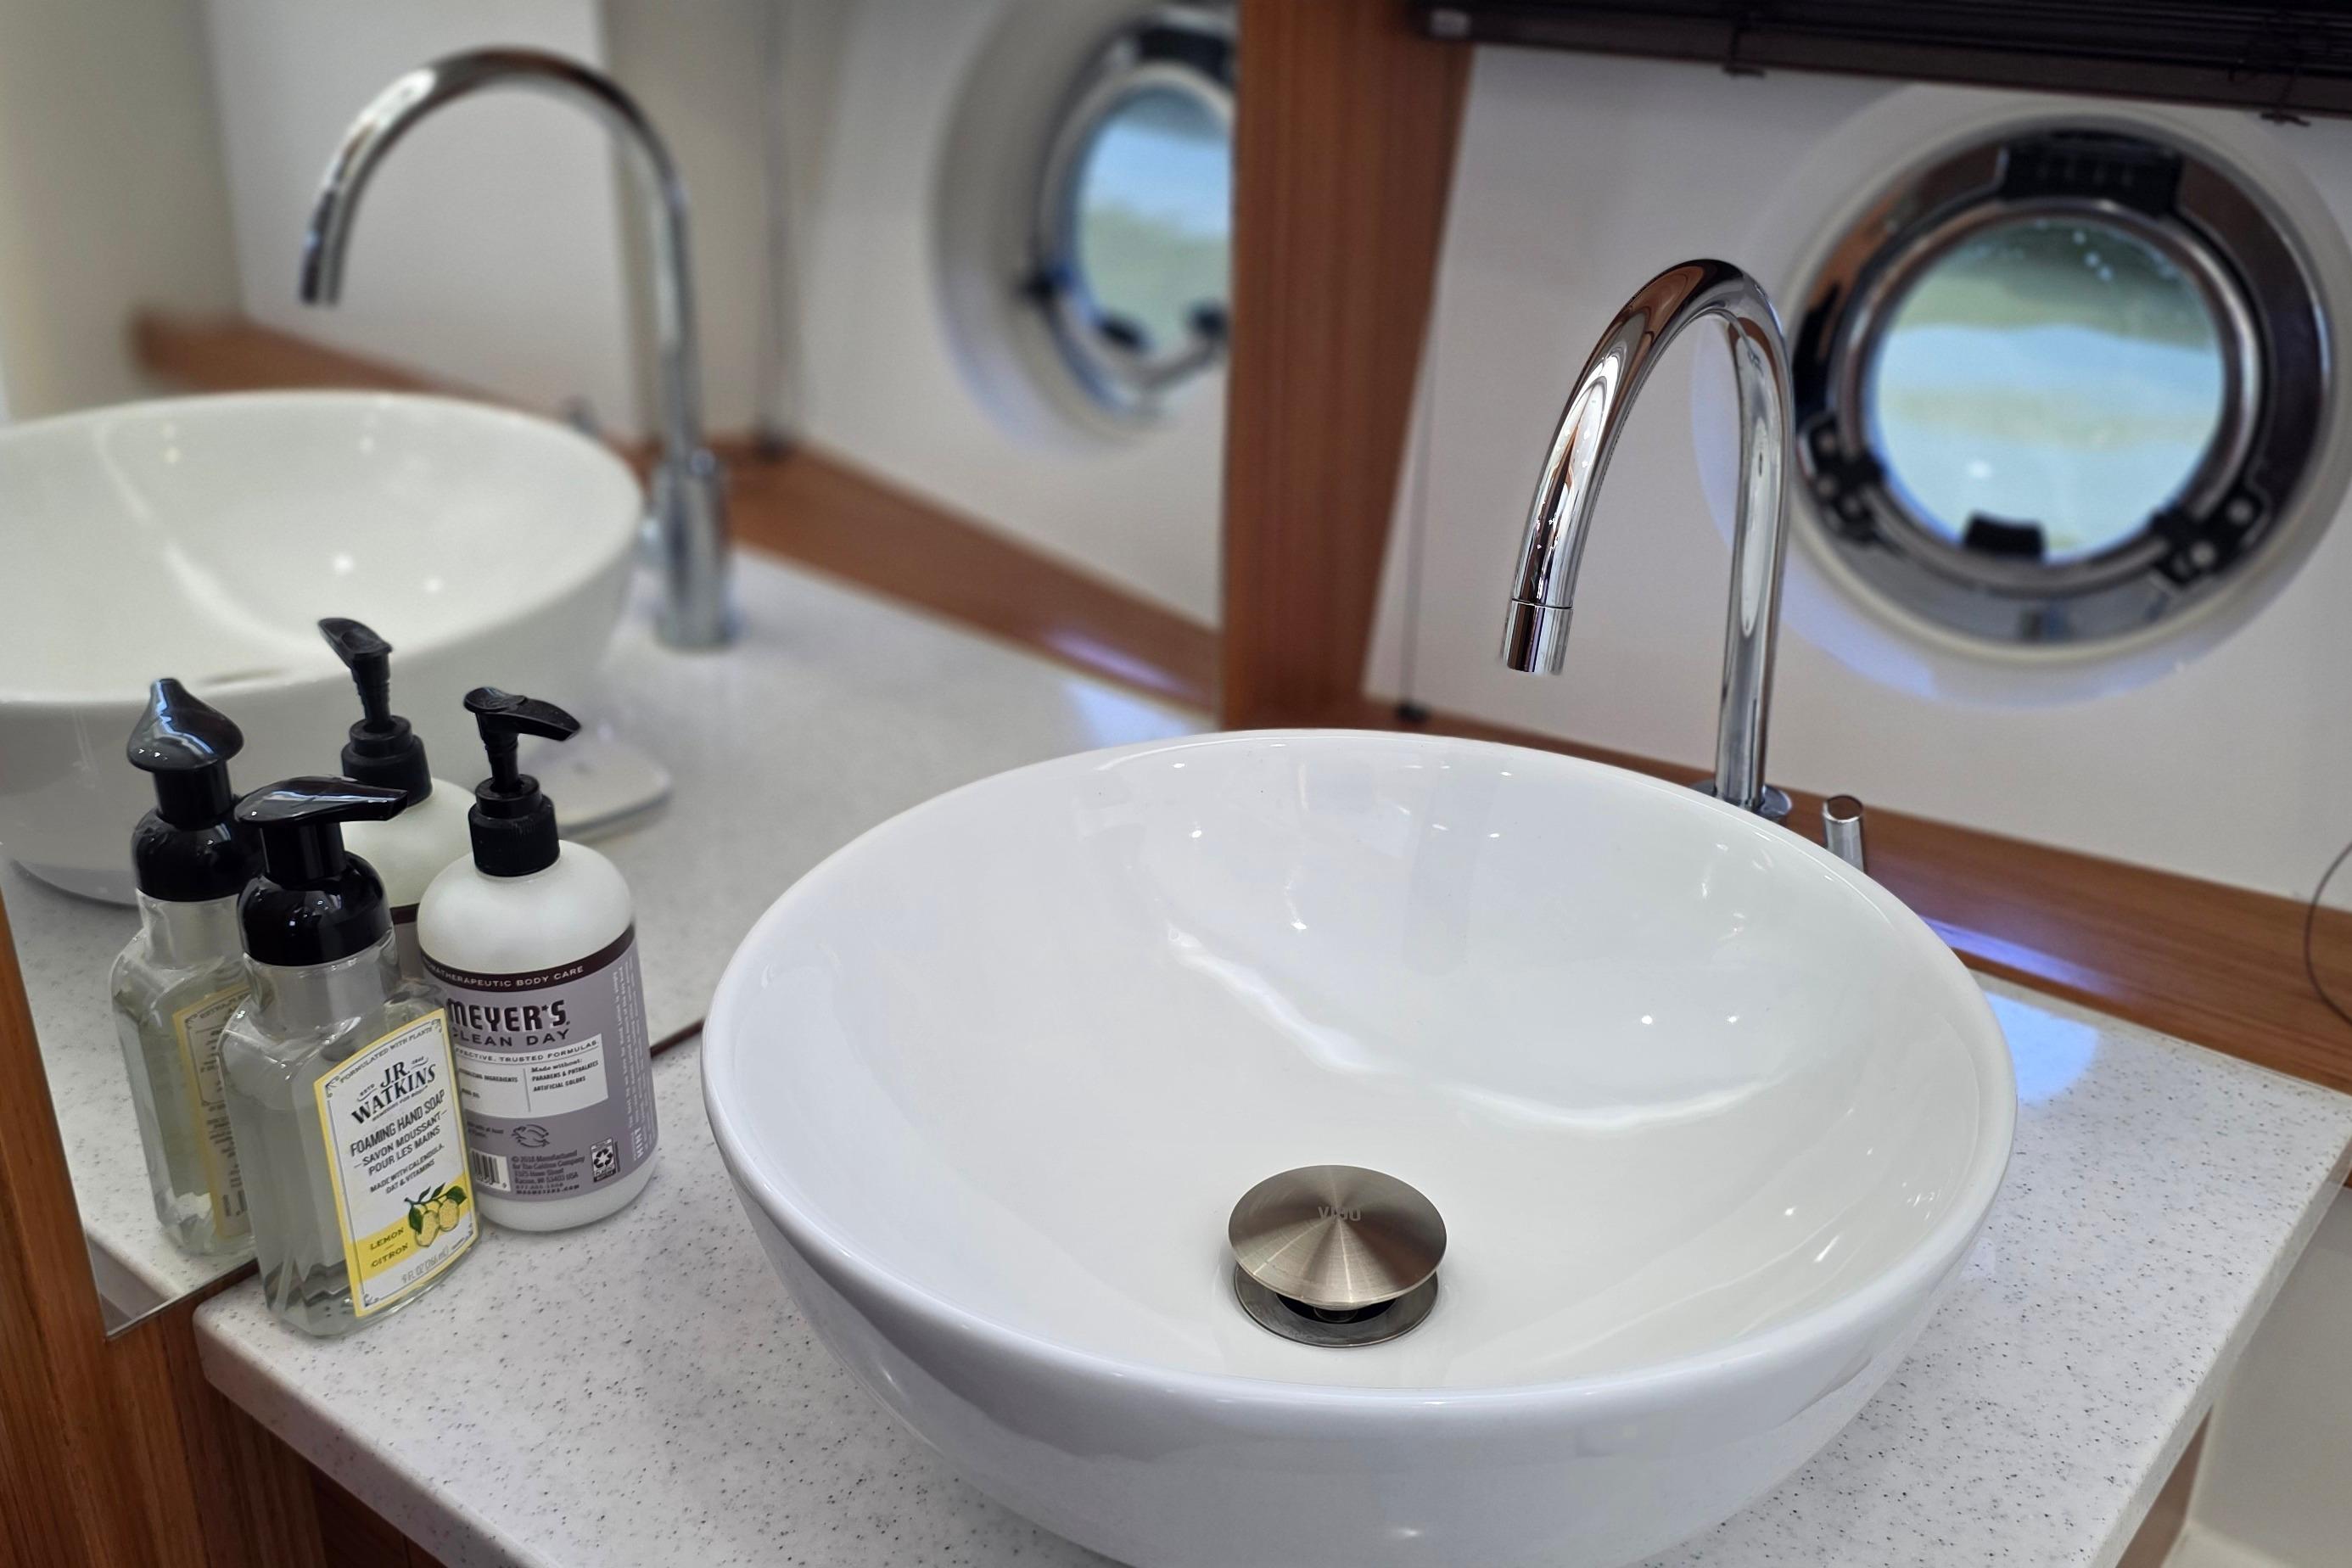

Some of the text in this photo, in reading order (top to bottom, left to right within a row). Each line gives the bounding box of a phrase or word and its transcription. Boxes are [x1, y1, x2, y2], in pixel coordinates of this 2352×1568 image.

[516, 975, 549, 986] BODY
[553, 966, 585, 981] CARE
[526, 1028, 570, 1047] DAY
[351, 1063, 437, 1124] WATKINS
[534, 1082, 564, 1092] ARTIFICIAL
[350, 1122, 396, 1156] FOAMING
[397, 1106, 423, 1132] HAND
[423, 1089, 445, 1115] SOAP
[362, 1143, 394, 1167] SAVON
[395, 1111, 441, 1148] MOUSSANT
[368, 1125, 441, 1176] POUR LES MAINS
[370, 1176, 391, 1192] MADE
[391, 1167, 408, 1181] WITH
[386, 1182, 399, 1195] OAT
[406, 1158, 435, 1181] VITAMINS
[370, 1227, 404, 1251] LEMON
[371, 1242, 408, 1268] CITRON
